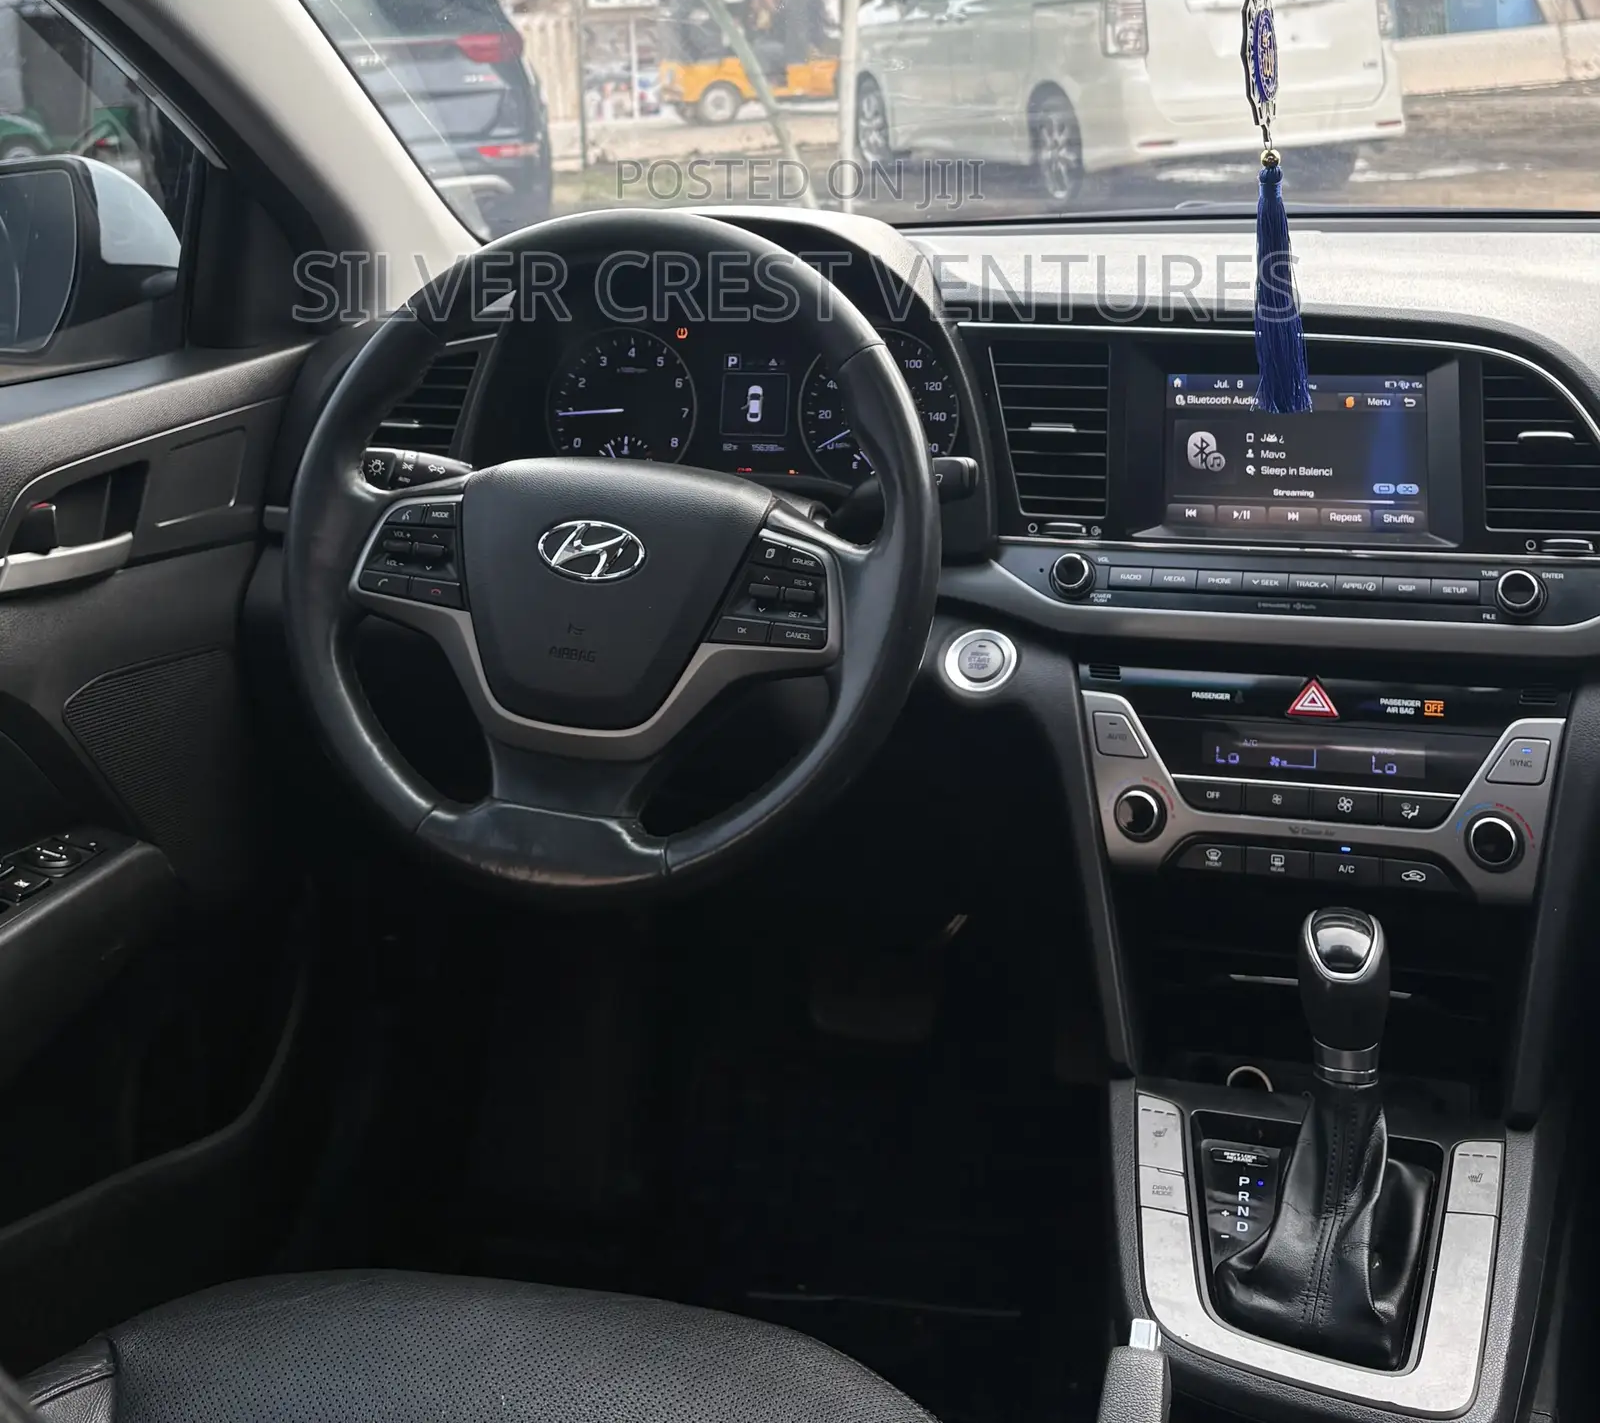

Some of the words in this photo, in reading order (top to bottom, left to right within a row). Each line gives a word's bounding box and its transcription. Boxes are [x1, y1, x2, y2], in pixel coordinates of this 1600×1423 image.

[627, 347, 636, 358] 4
[600, 356, 608, 367] 3
[656, 356, 665, 367] 5
[728, 356, 738, 368] P
[904, 359, 923, 369] 100
[577, 378, 586, 388] 2
[675, 378, 684, 389] 6
[924, 381, 942, 391] 120
[1213, 379, 1230, 389] Jul.
[1187, 395, 1231, 405] Bluetooth
[1367, 397, 1391, 407] Menu
[681, 408, 690, 419] 7
[818, 409, 832, 419] 20
[928, 412, 947, 422] 140
[573, 437, 582, 448] 0
[670, 437, 679, 448] 8
[1260, 449, 1286, 459] Mavo
[1260, 465, 1287, 477] Sleep
[1288, 466, 1297, 476] in
[1273, 488, 1315, 498] Streaming
[431, 511, 450, 519] MODE
[1329, 512, 1363, 523] Repeat
[1383, 513, 1415, 524] Shuffle
[792, 557, 816, 567] CRUISE
[1120, 573, 1142, 581] RADIO
[1163, 574, 1186, 583] MEDIA
[1481, 570, 1499, 578] TUNE
[1541, 571, 1564, 579] ENTER
[1207, 577, 1232, 585] PHONE
[1260, 579, 1280, 587] SEEK
[1295, 580, 1320, 588] TRACK
[1398, 584, 1416, 592] DISP
[1442, 586, 1468, 594] SETUP
[1482, 613, 1496, 621] FILE
[785, 631, 811, 640] CANCEL
[1191, 691, 1231, 701] PASSENGER
[1379, 698, 1422, 708] PASSENGER
[1424, 702, 1444, 714] OFF
[1399, 707, 1415, 715] BAG
[1509, 759, 1533, 768] SYNC
[1206, 791, 1221, 799] OFF
[1338, 864, 1355, 874] A/C
[1239, 1176, 1250, 1187] P
[1238, 1191, 1250, 1202] R
[1237, 1206, 1249, 1217] N
[1236, 1221, 1249, 1232] D
